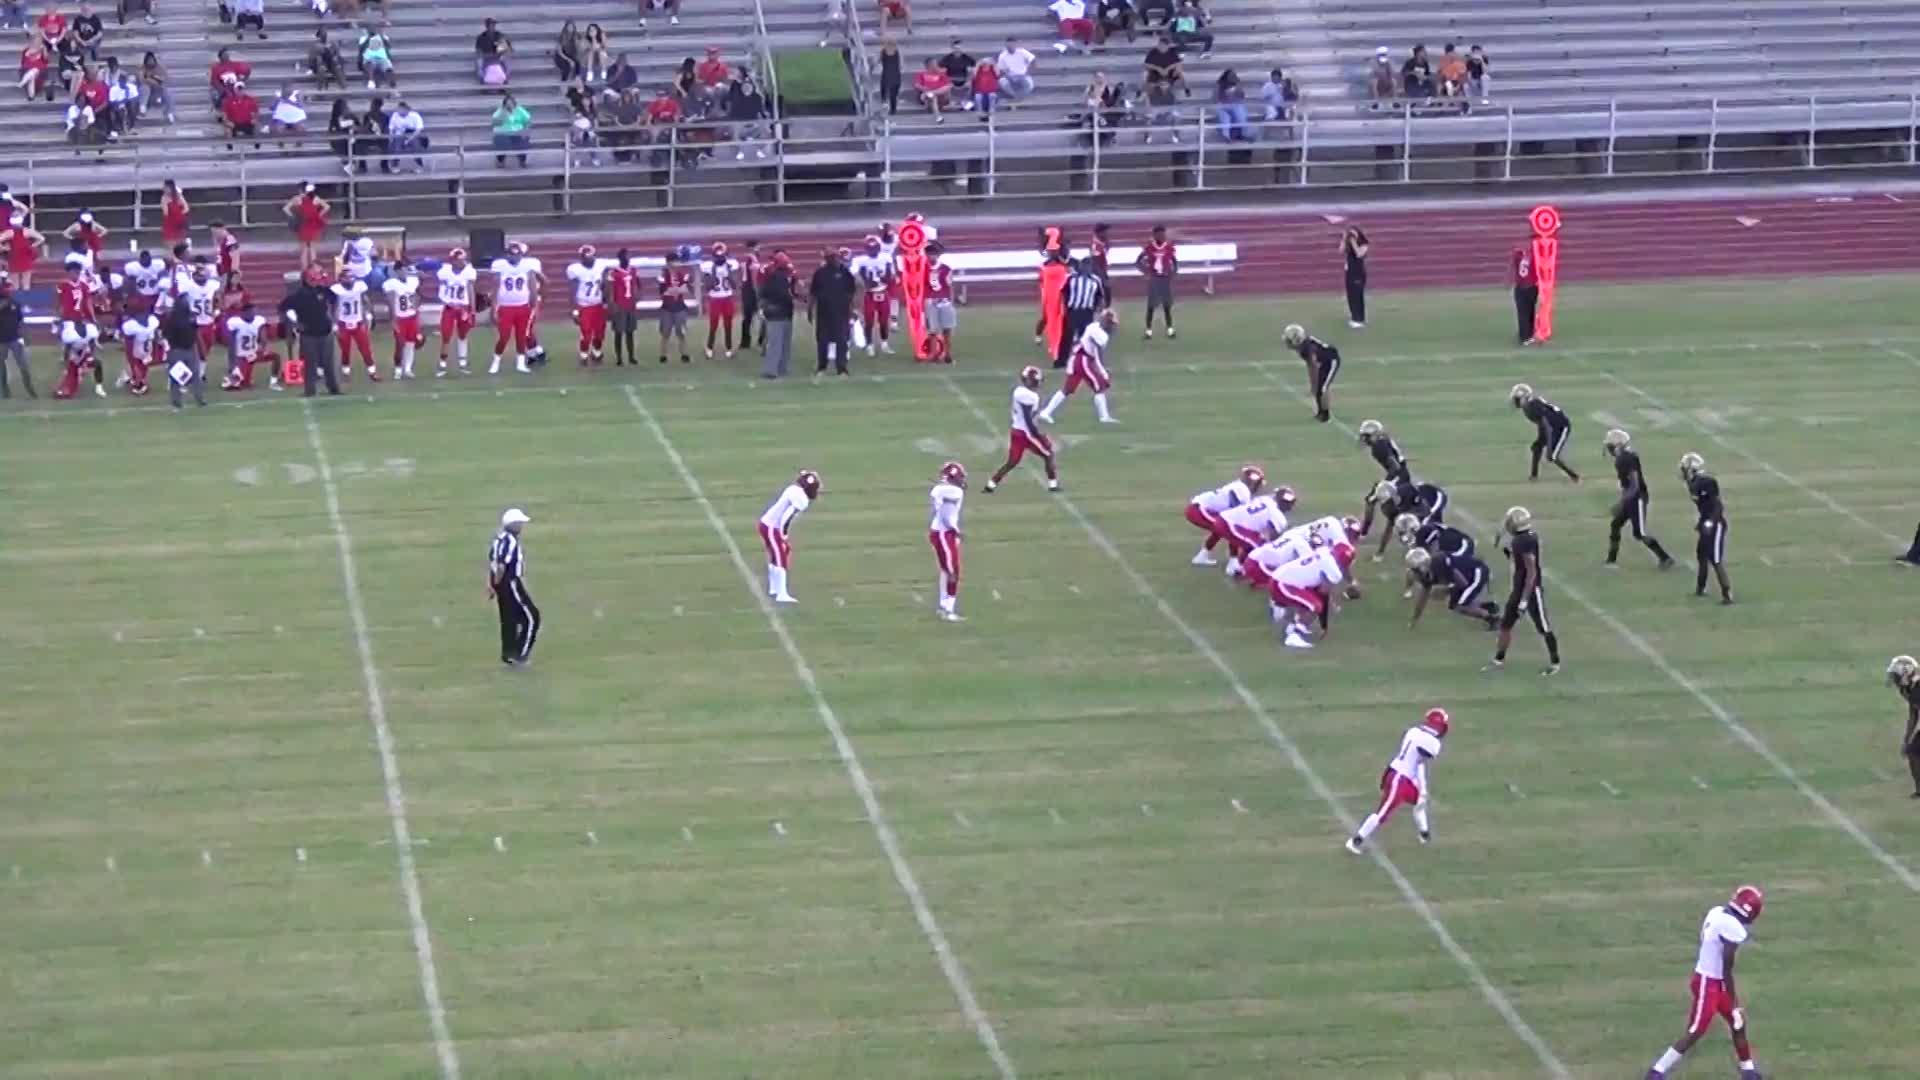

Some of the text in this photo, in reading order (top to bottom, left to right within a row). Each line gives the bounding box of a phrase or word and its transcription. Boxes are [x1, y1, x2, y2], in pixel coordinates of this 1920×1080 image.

[1045, 227, 1061, 250] 2
[623, 275, 633, 298] 1
[72, 289, 84, 311] 7
